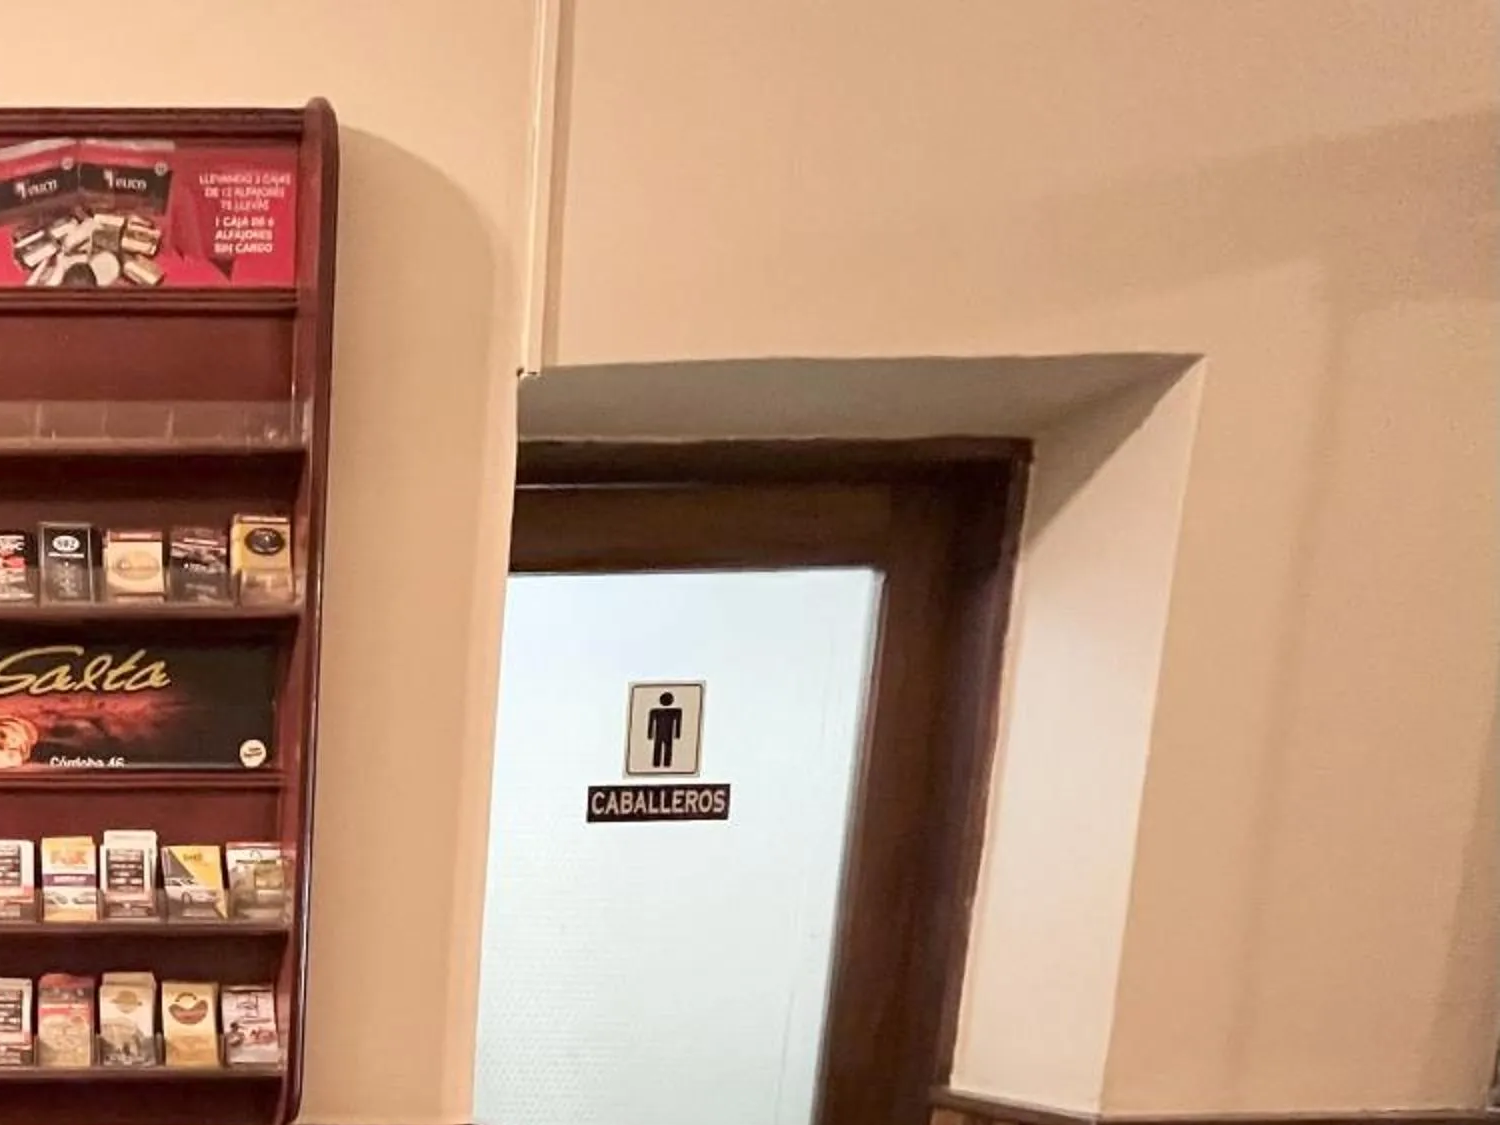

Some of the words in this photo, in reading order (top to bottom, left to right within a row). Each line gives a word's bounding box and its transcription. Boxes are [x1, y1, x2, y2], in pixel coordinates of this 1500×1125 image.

[223, 215, 249, 229] CAJA
[215, 230, 273, 242] ALFAJORES
[591, 788, 726, 815] CABALLEROS
